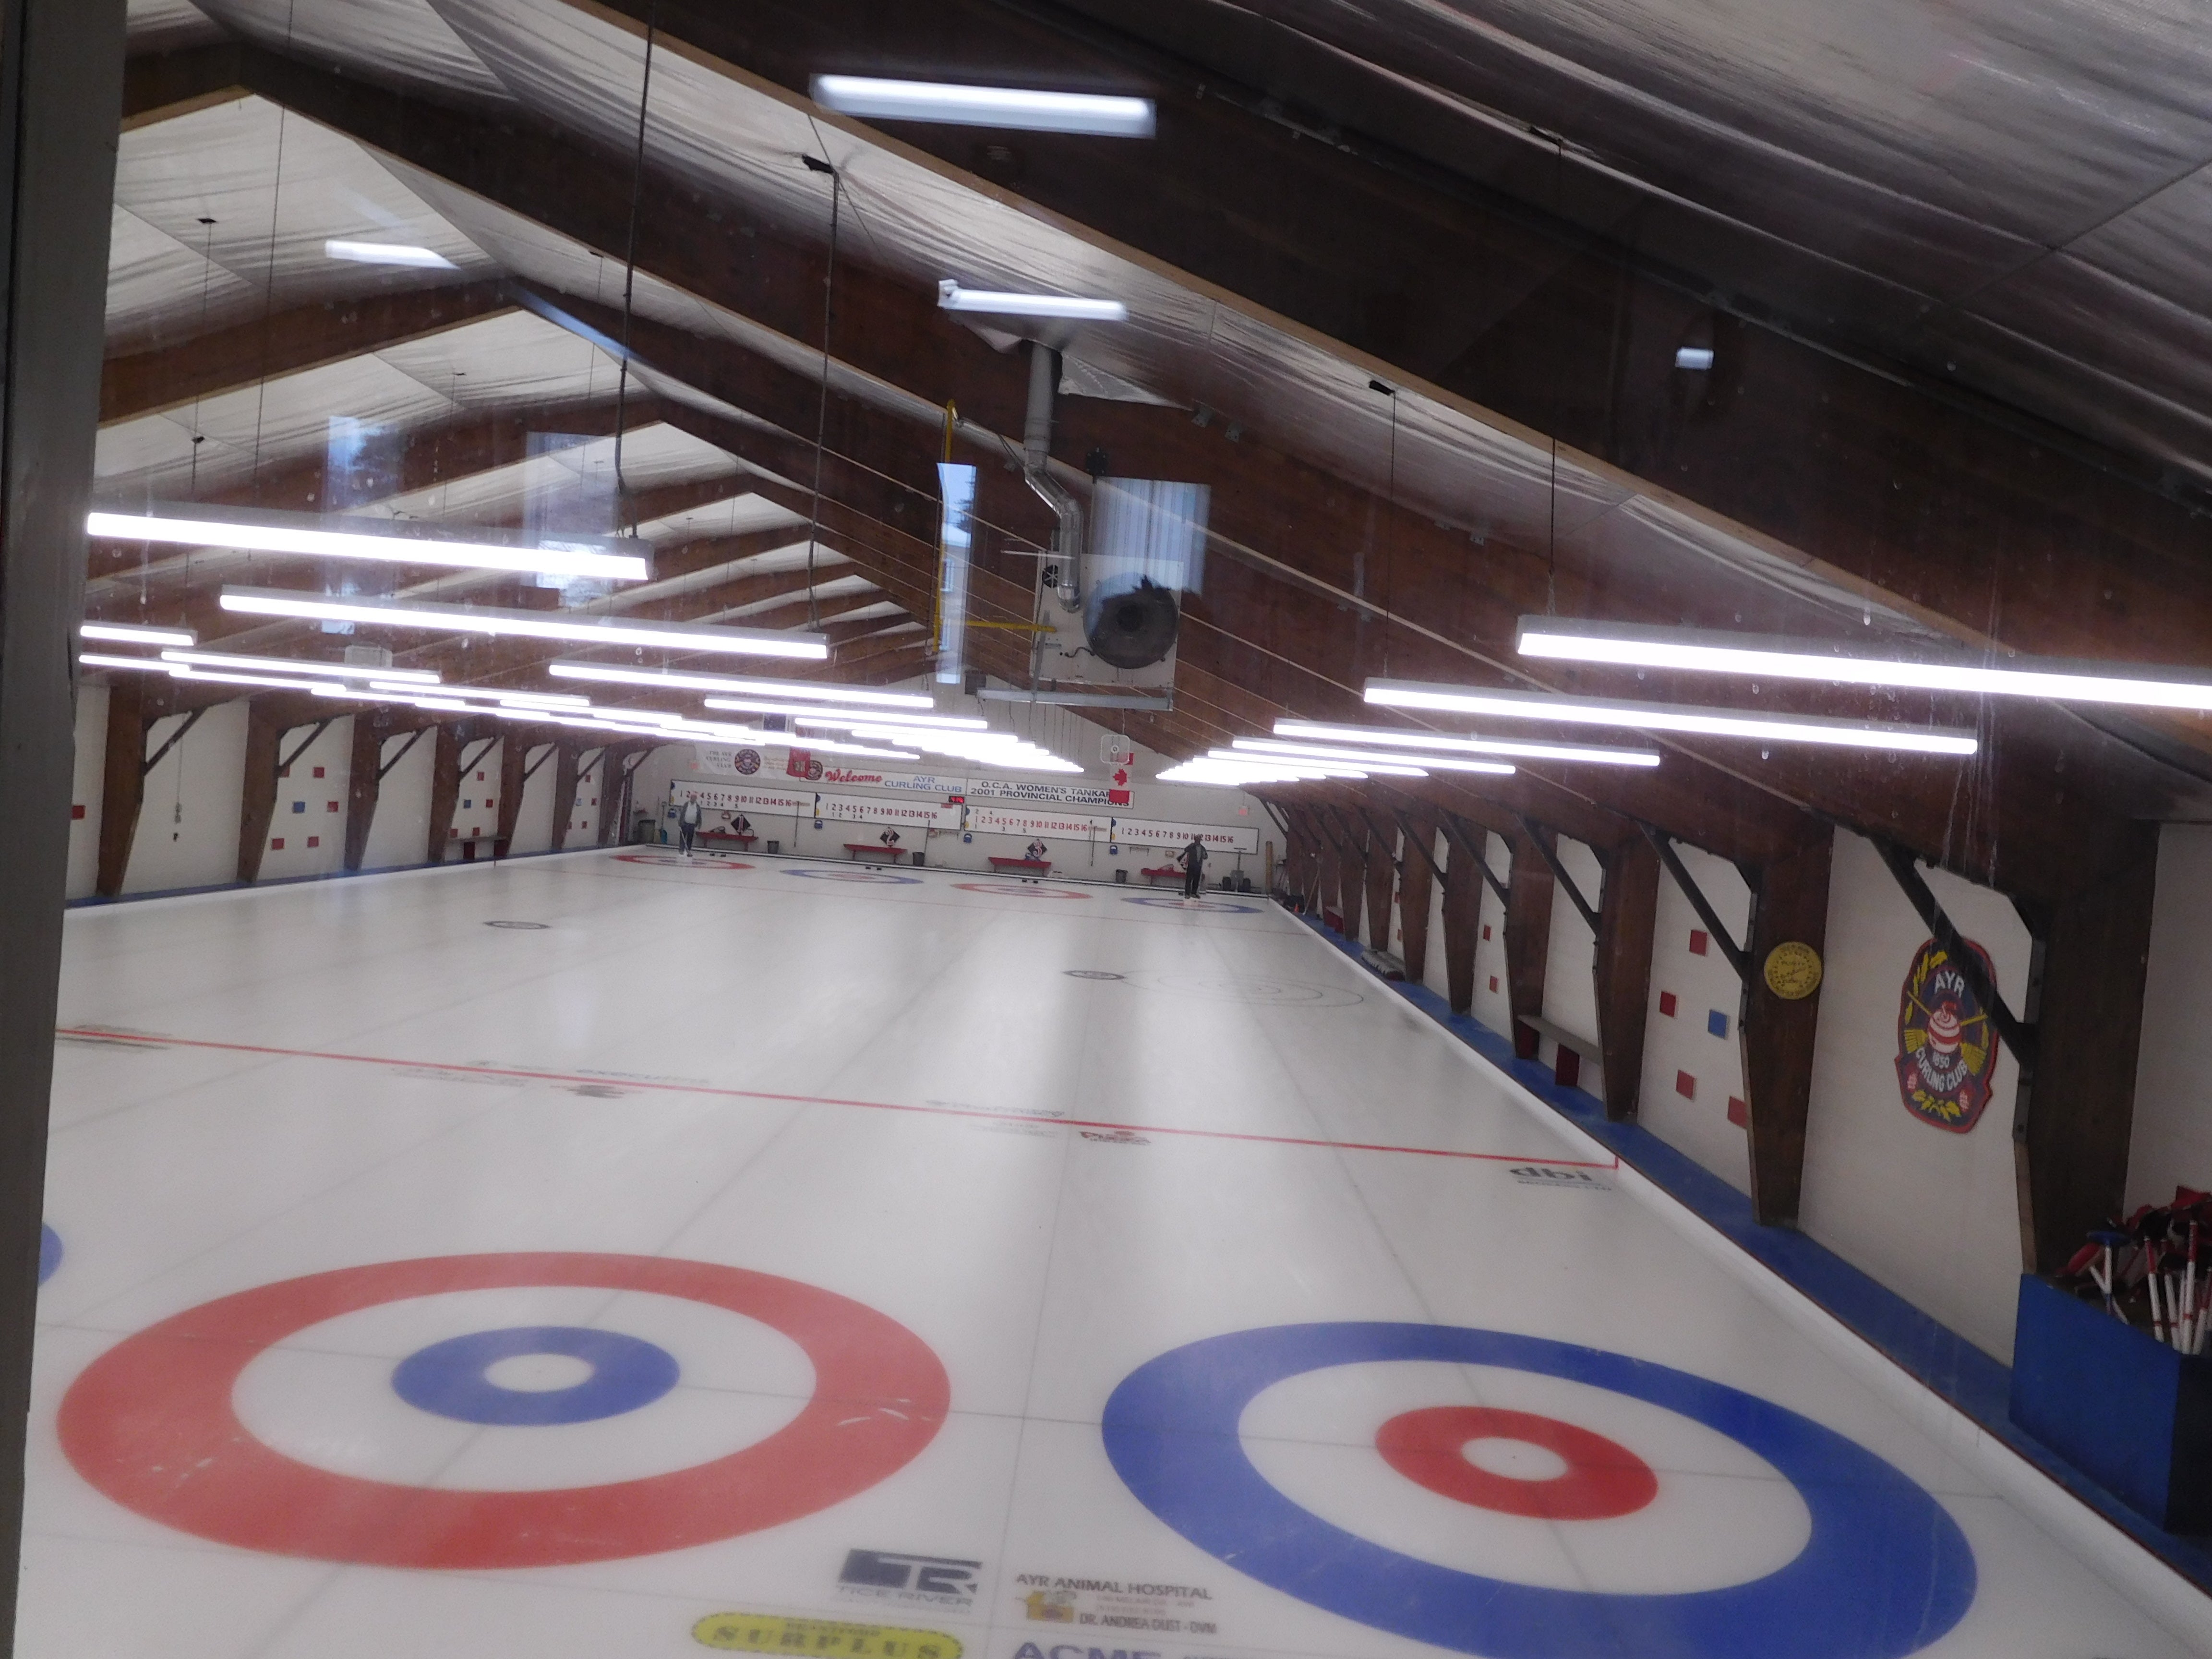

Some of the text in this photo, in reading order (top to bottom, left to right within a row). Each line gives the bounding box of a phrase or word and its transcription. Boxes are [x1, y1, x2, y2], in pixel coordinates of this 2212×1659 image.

[825, 769, 882, 782] Welcome
[914, 775, 935, 783] AYR
[884, 780, 962, 792] CURLING CLUB
[981, 781, 1109, 797] O.C.A. WOMEN'S TANKA
[999, 790, 1062, 801] PROVINCIAL
[885, 829, 895, 846] 2
[1033, 841, 1043, 857] 3
[1935, 971, 1965, 998] AYR
[1916, 1047, 1967, 1092] CURLING CLUB
[1016, 1574, 1213, 1600] AYR ANIMAL HOSPITAL
[898, 1591, 974, 1606] RIVER
[713, 1626, 942, 1659] SURPLUS
